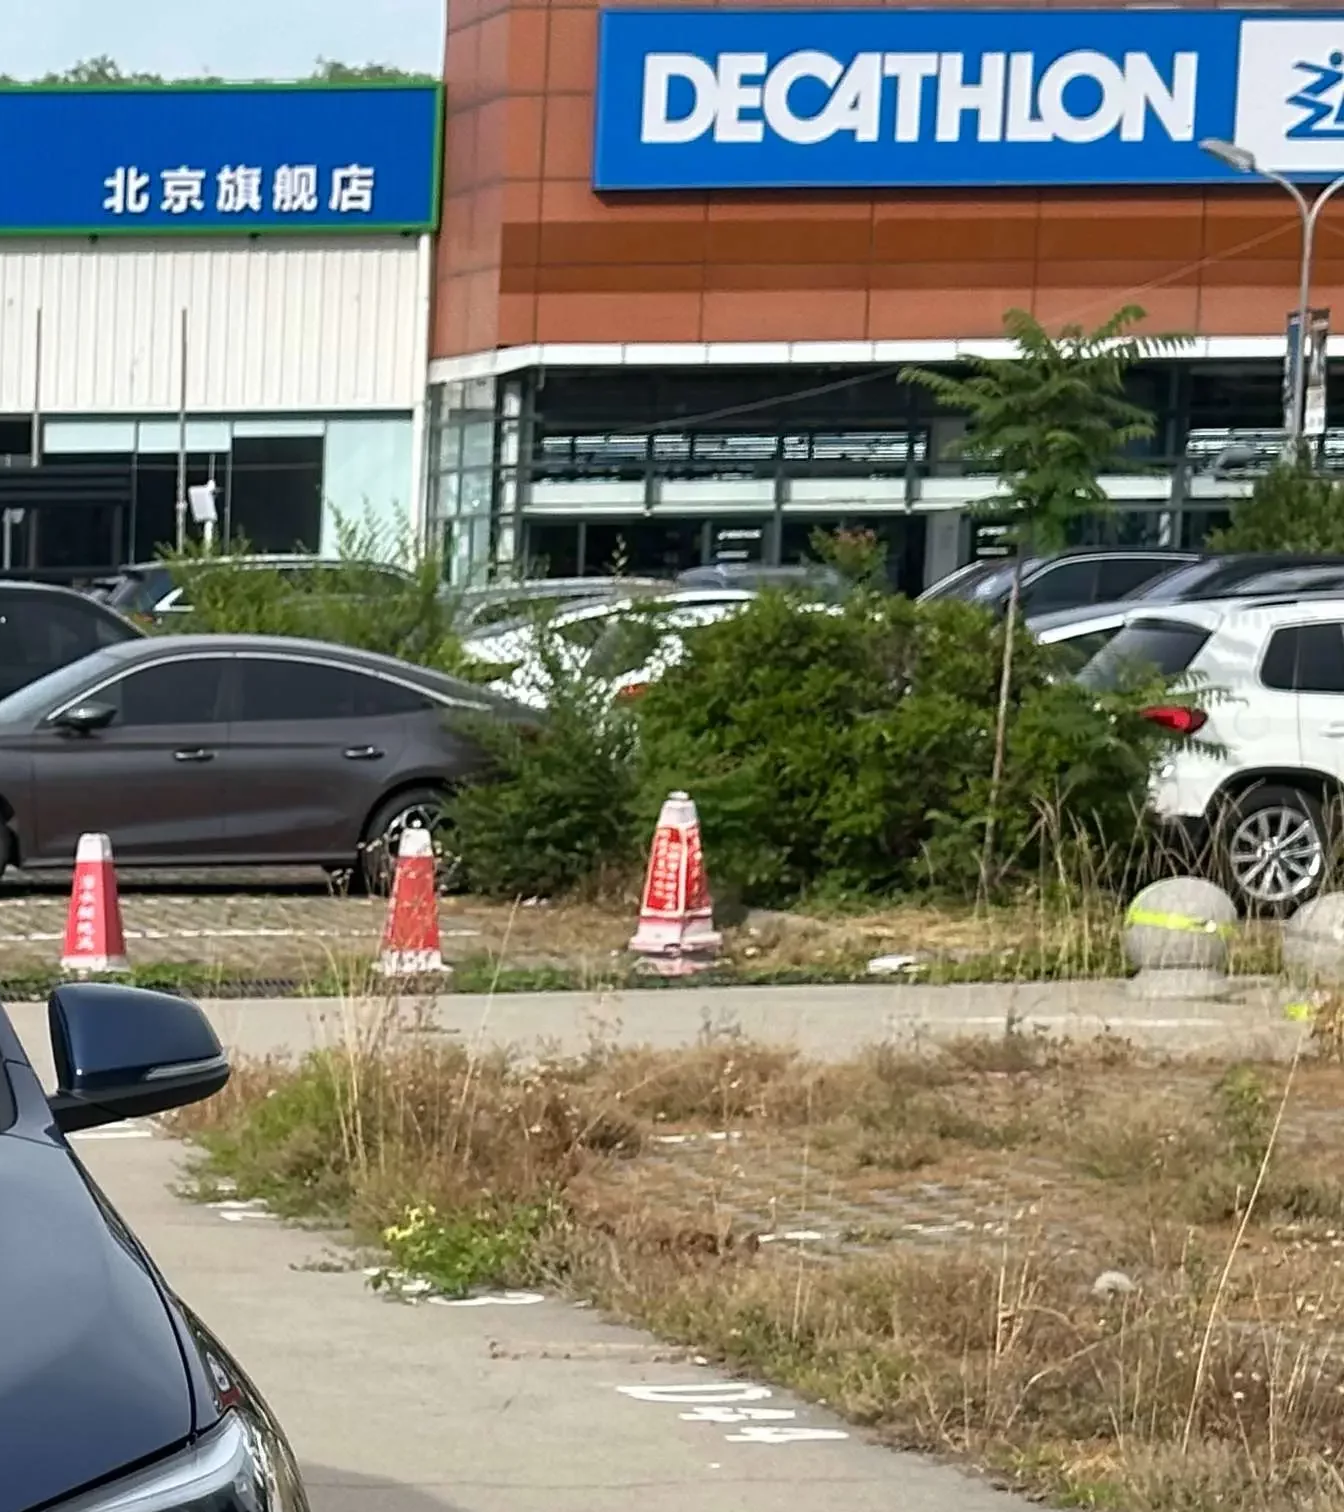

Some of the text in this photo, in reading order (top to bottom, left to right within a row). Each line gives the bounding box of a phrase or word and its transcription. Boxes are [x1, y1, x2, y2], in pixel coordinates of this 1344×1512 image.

[640, 49, 1200, 144] DECATHLON
[103, 163, 376, 214] 北京旗舰店
